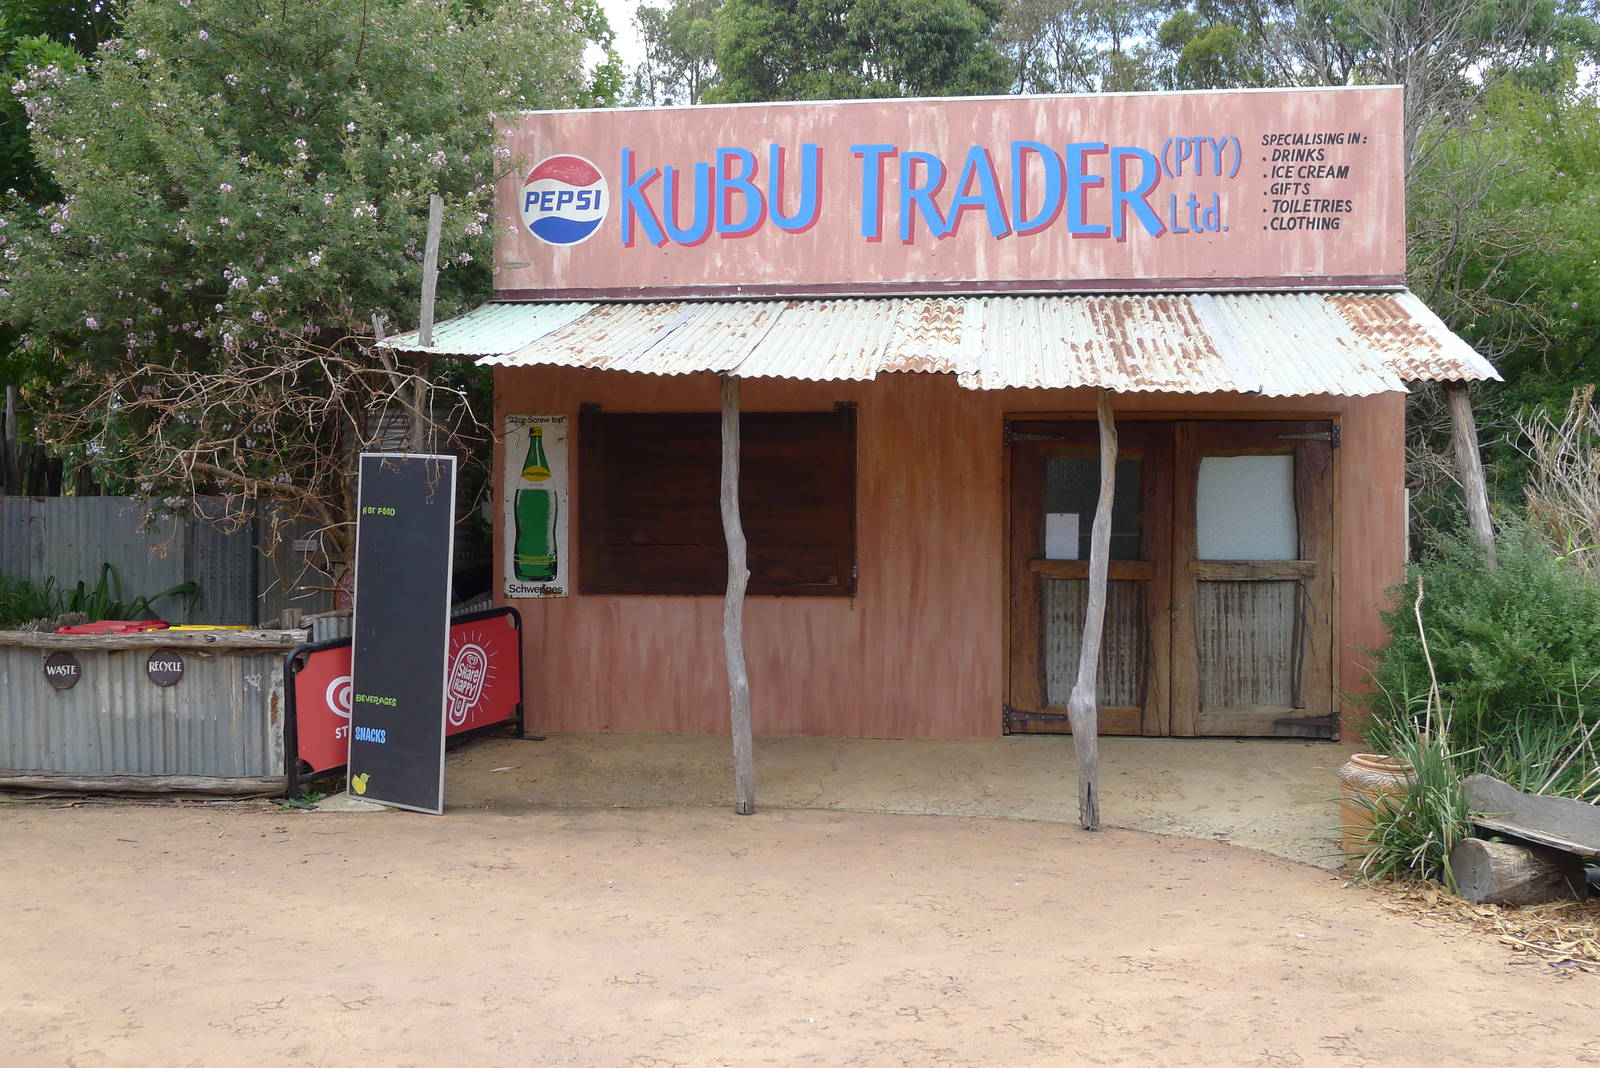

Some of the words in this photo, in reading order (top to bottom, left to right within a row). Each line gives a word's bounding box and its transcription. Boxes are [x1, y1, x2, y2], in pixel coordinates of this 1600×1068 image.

[1262, 133, 1344, 146] SPECIALISING
[1161, 136, 1242, 179] (PTY)
[1272, 148, 1325, 162] DRINKS
[1271, 165, 1294, 179] ICE
[1298, 165, 1350, 179] CREAM
[621, 143, 823, 248] KUBU
[850, 141, 1167, 245] TRADER
[1270, 182, 1311, 195] GIFTS
[524, 189, 602, 213] PEPSI
[1272, 199, 1353, 213] TOILETRIES
[1170, 192, 1229, 234] Ltd.
[1270, 217, 1340, 231] CLOTHING
[377, 507, 396, 517] FOOD
[509, 584, 563, 595] Schweppes
[46, 665, 77, 676] WASTE
[149, 661, 182, 672] RECYCLE
[355, 694, 397, 707] BEVERAGES
[355, 726, 386, 744] SNACKS
